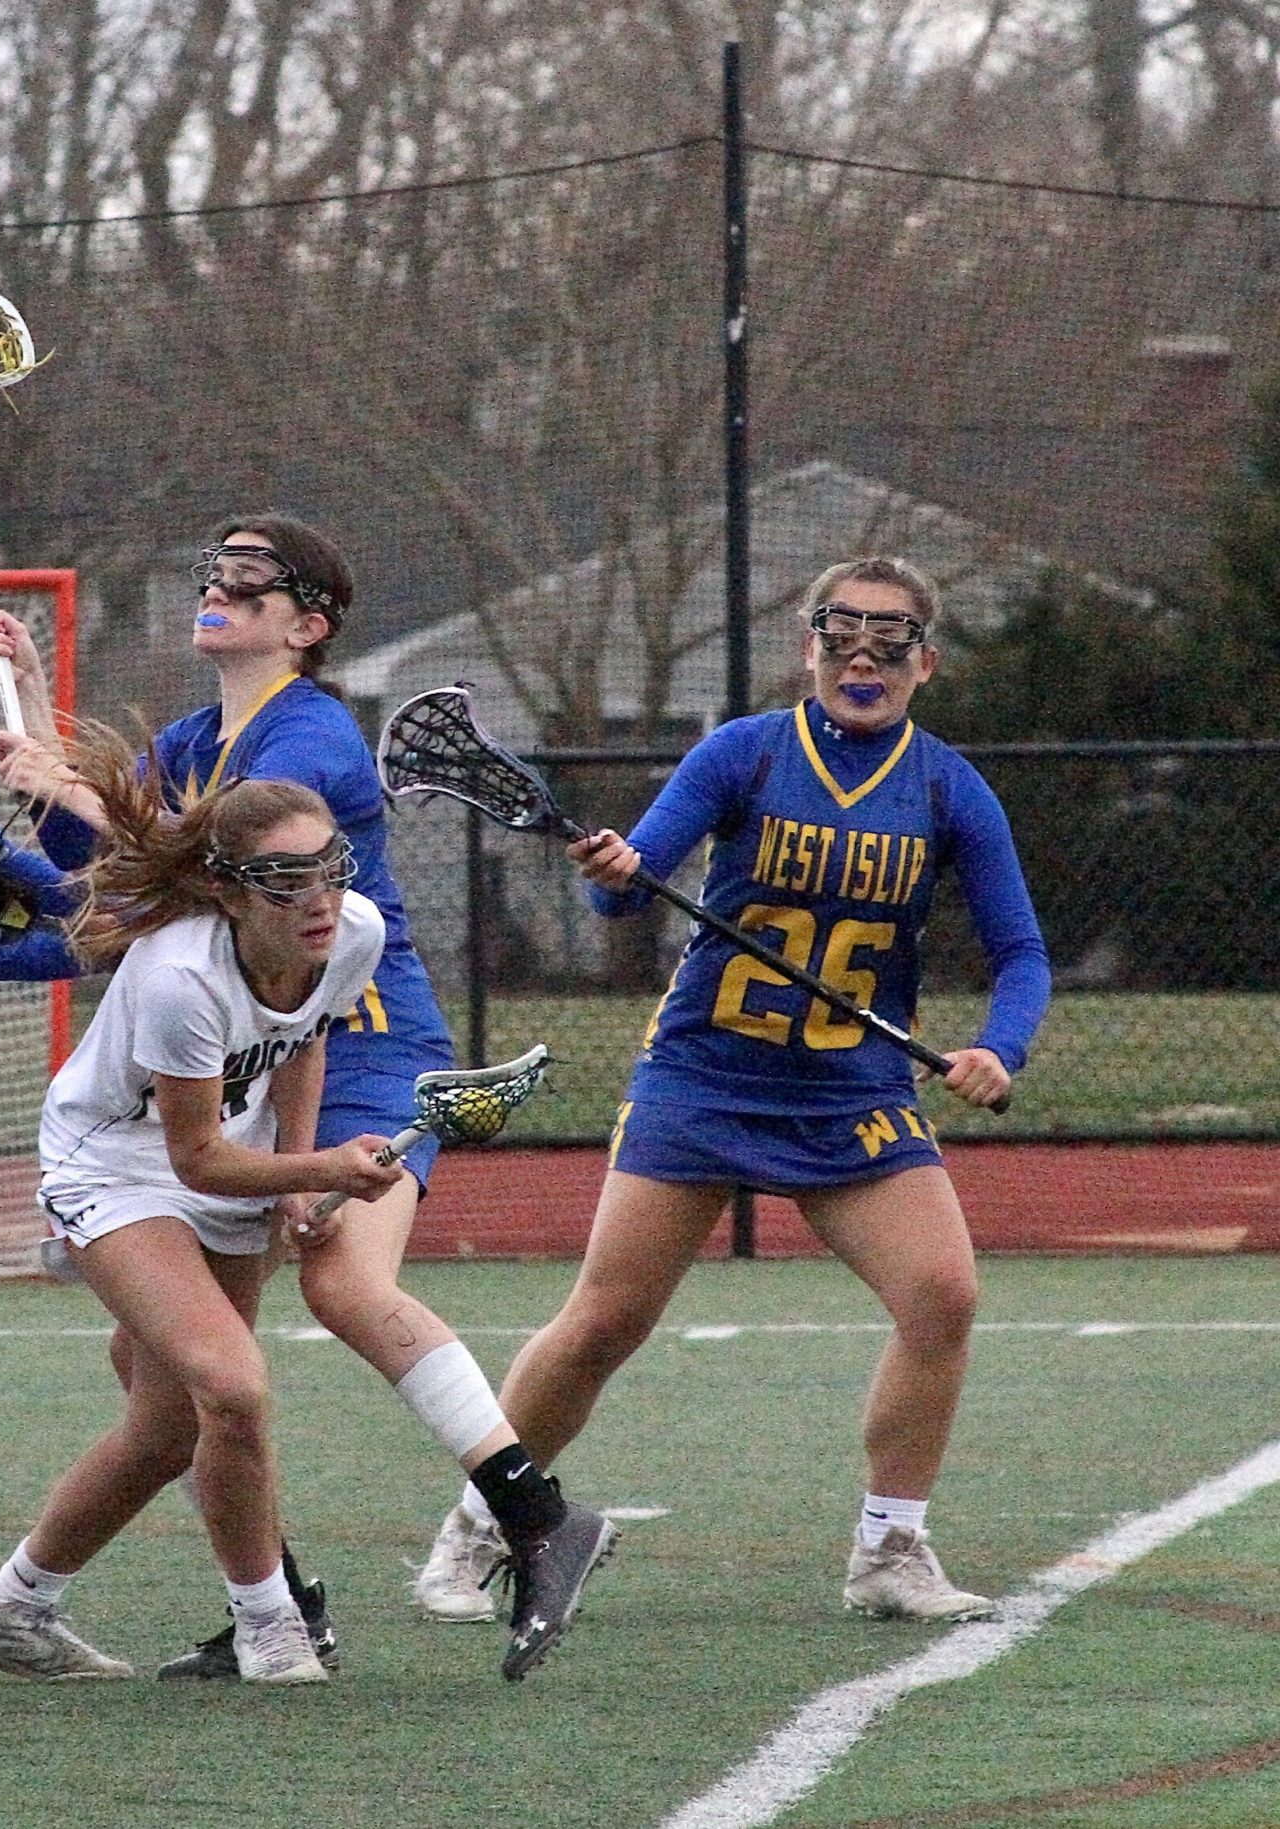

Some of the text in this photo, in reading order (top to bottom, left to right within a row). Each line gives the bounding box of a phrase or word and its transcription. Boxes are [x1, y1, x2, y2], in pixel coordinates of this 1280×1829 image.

[752, 815, 926, 905] WEST ISLIP
[712, 903, 897, 1050] 26
